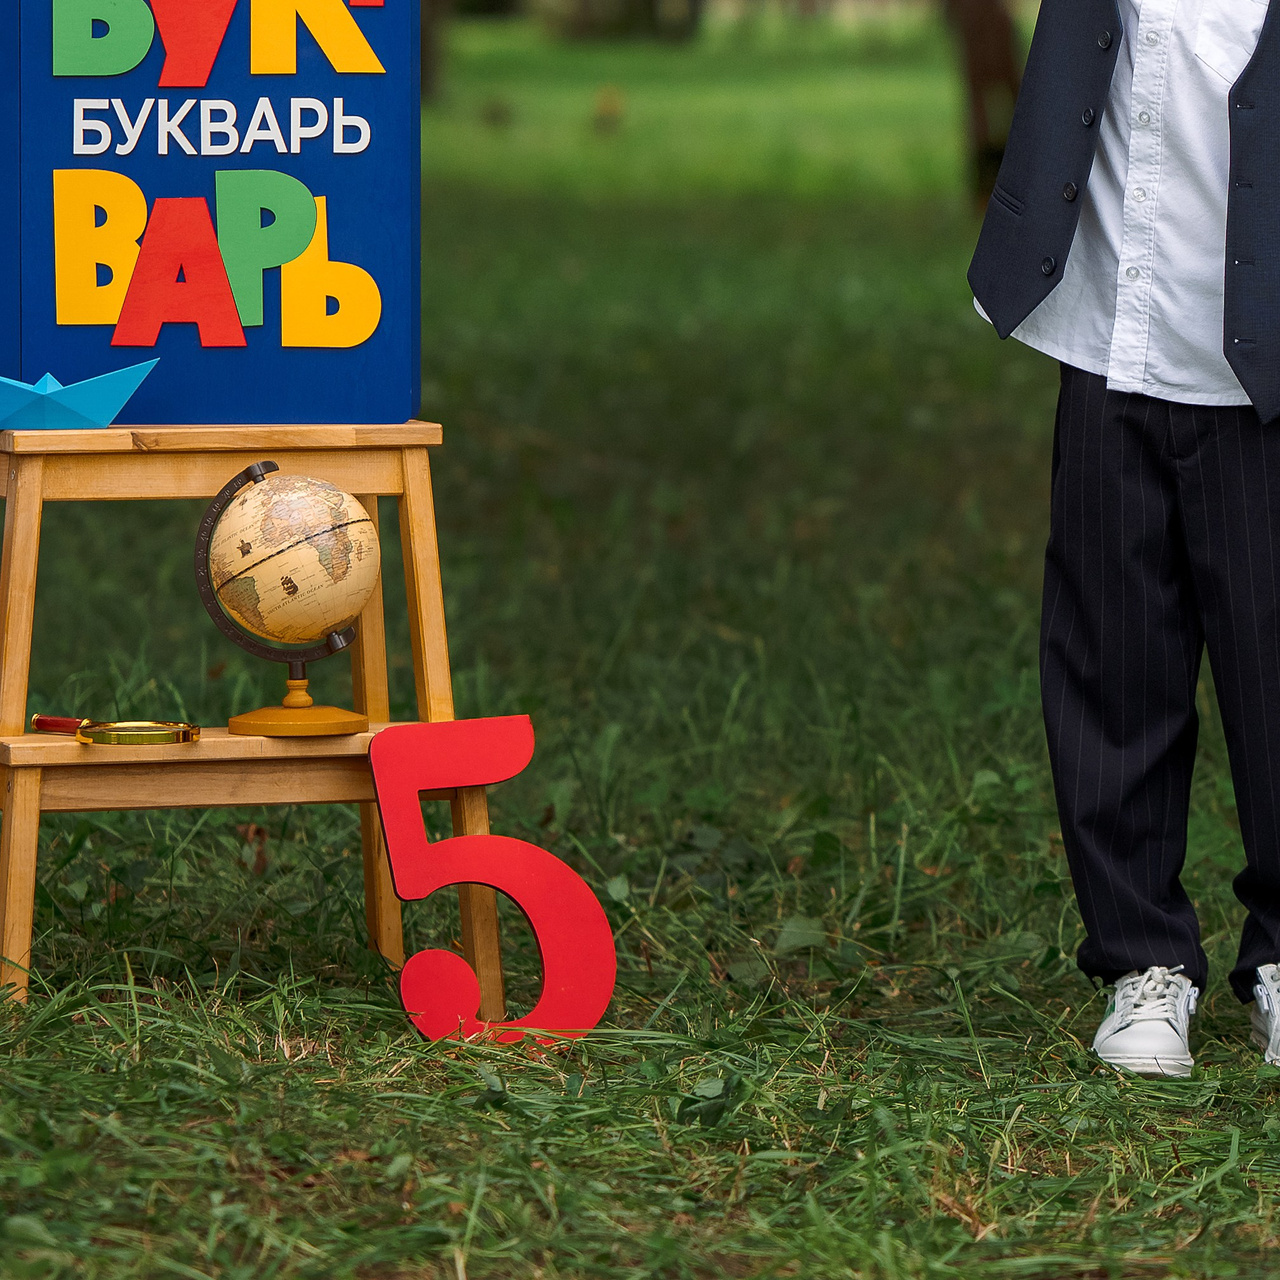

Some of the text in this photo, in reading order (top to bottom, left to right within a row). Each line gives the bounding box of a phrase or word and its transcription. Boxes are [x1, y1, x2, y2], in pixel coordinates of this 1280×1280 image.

[73, 97, 371, 156] БУКВАРЬ
[53, 169, 382, 348] ВАРЬ
[370, 715, 617, 1046] 5
